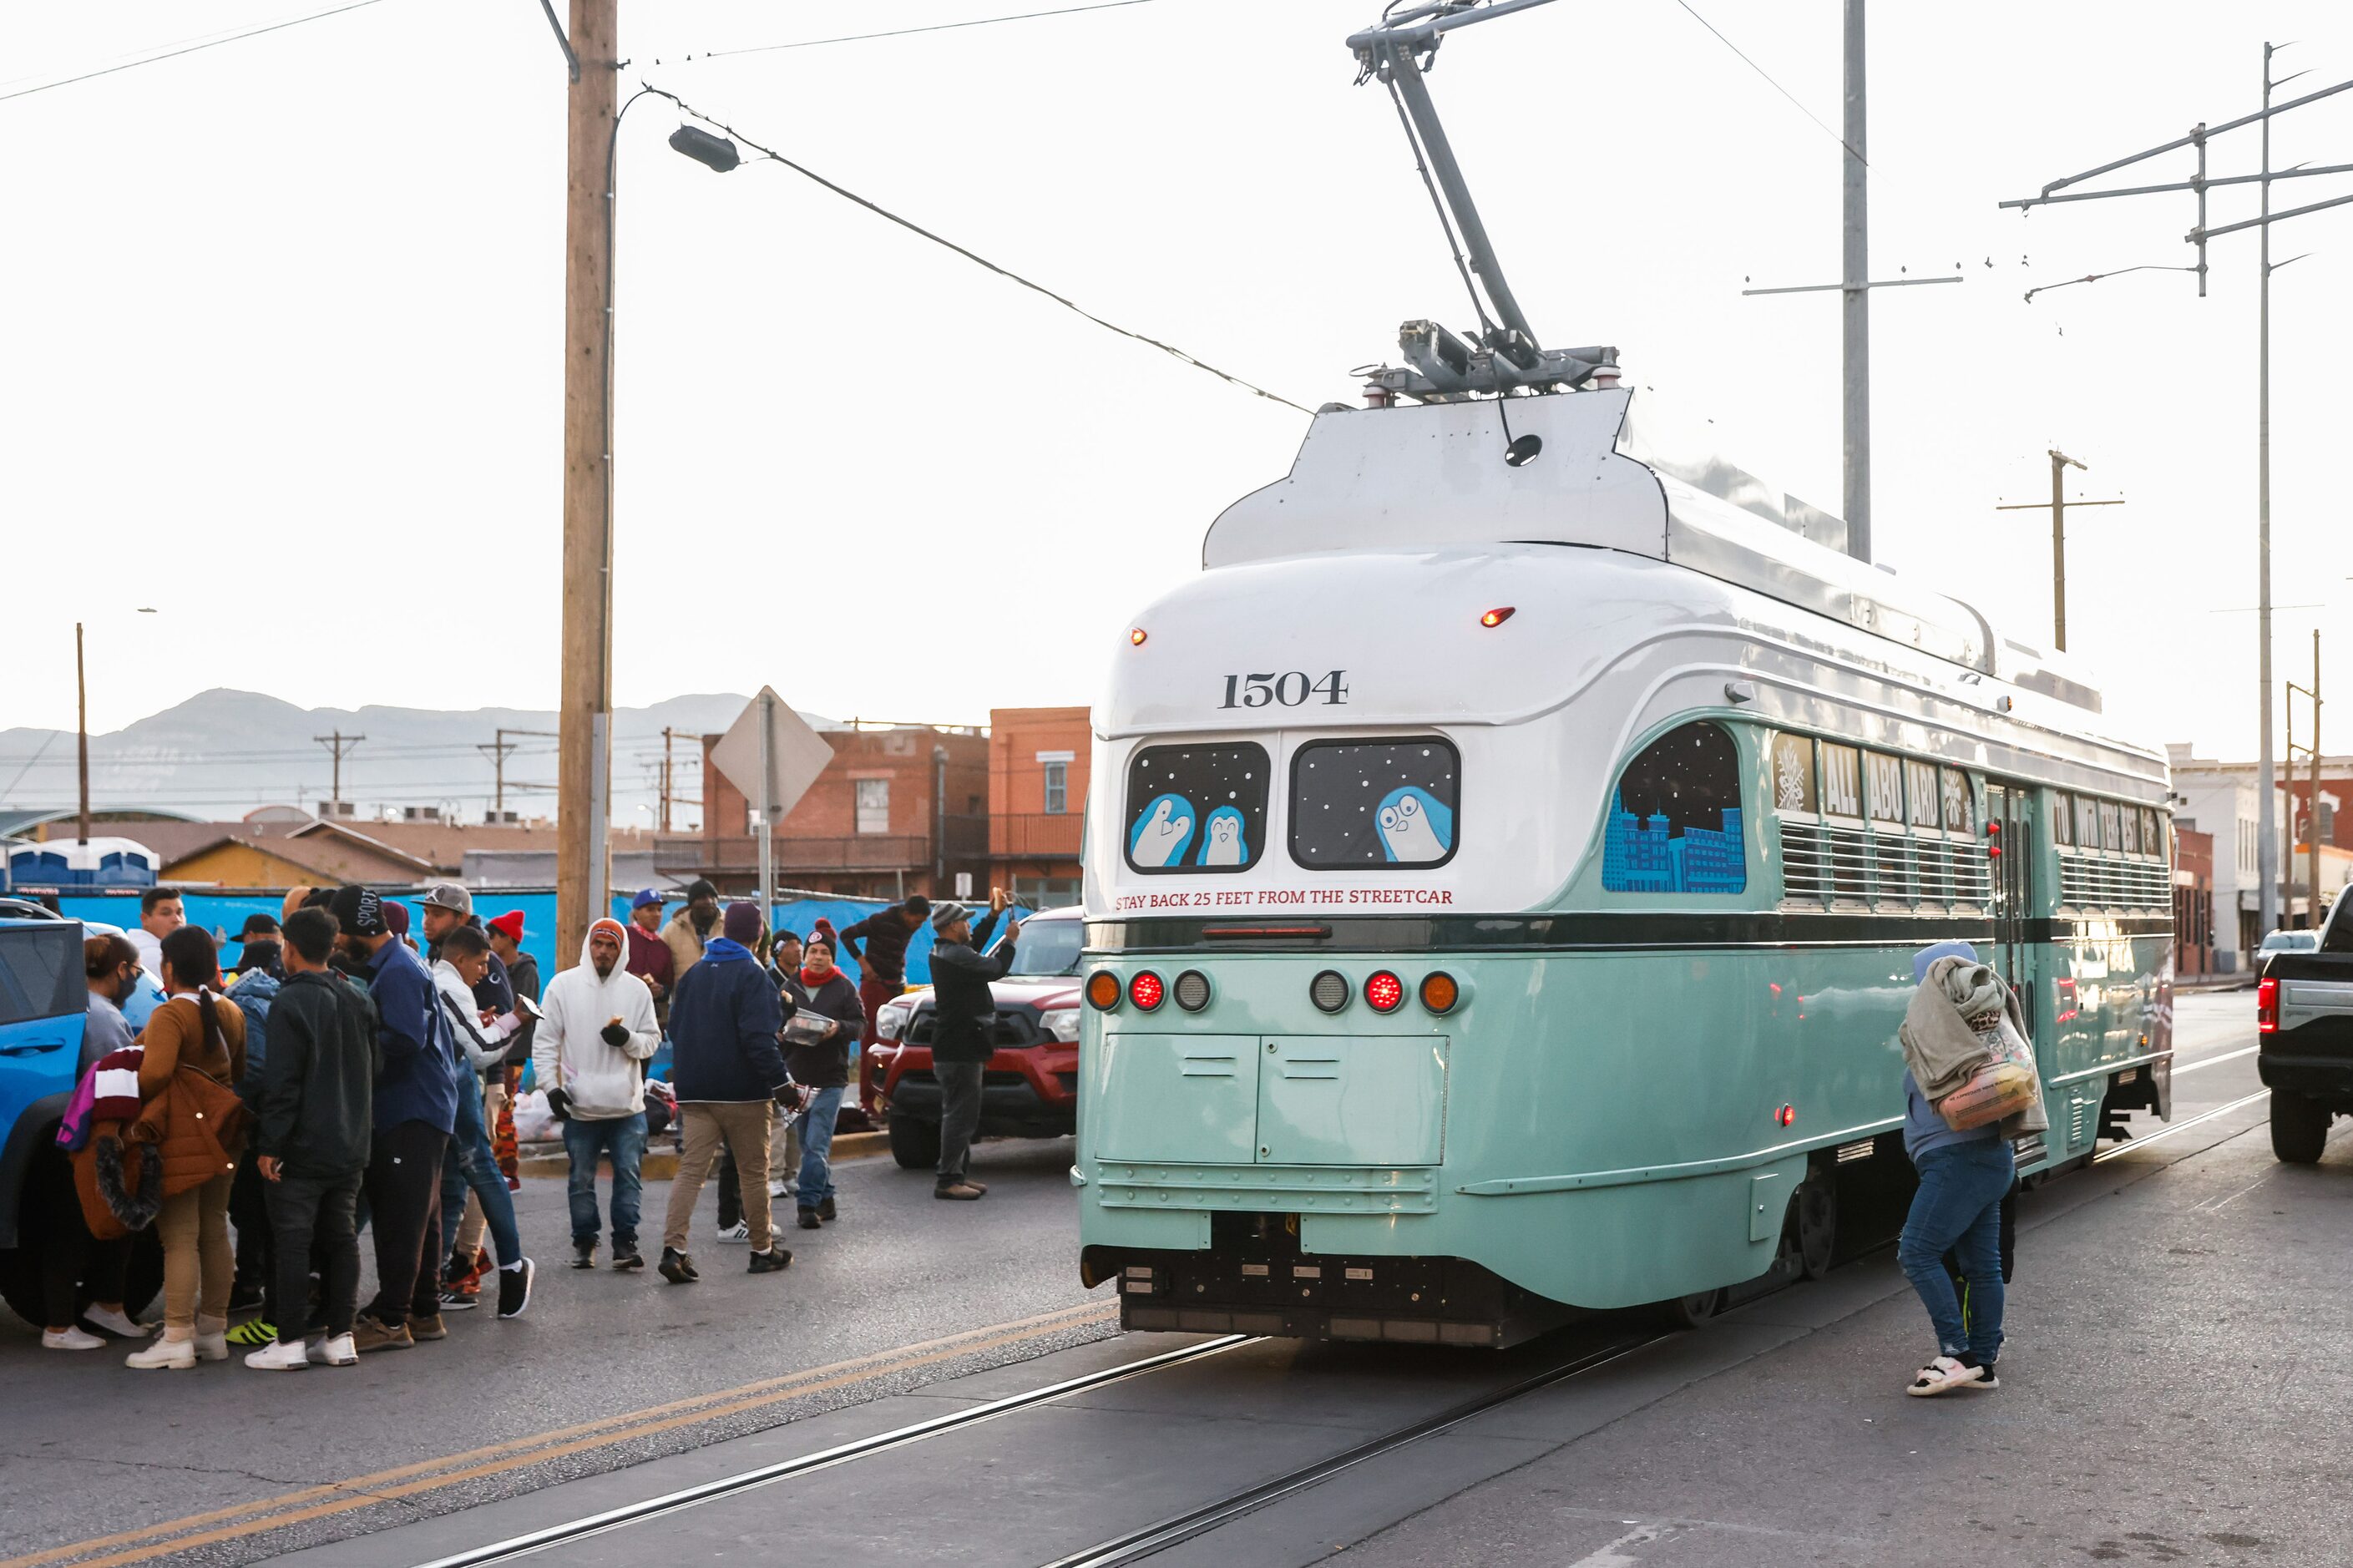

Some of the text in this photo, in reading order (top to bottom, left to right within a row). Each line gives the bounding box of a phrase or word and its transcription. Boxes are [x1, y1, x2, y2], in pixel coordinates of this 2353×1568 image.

[1217, 670, 1349, 710] 1504
[1826, 746, 1858, 816] ALL
[2054, 794, 2070, 844] TO
[357, 890, 378, 927] SPORT
[1116, 890, 1453, 910] STAY BACK 25 FEET FROM THE STREETCAR
